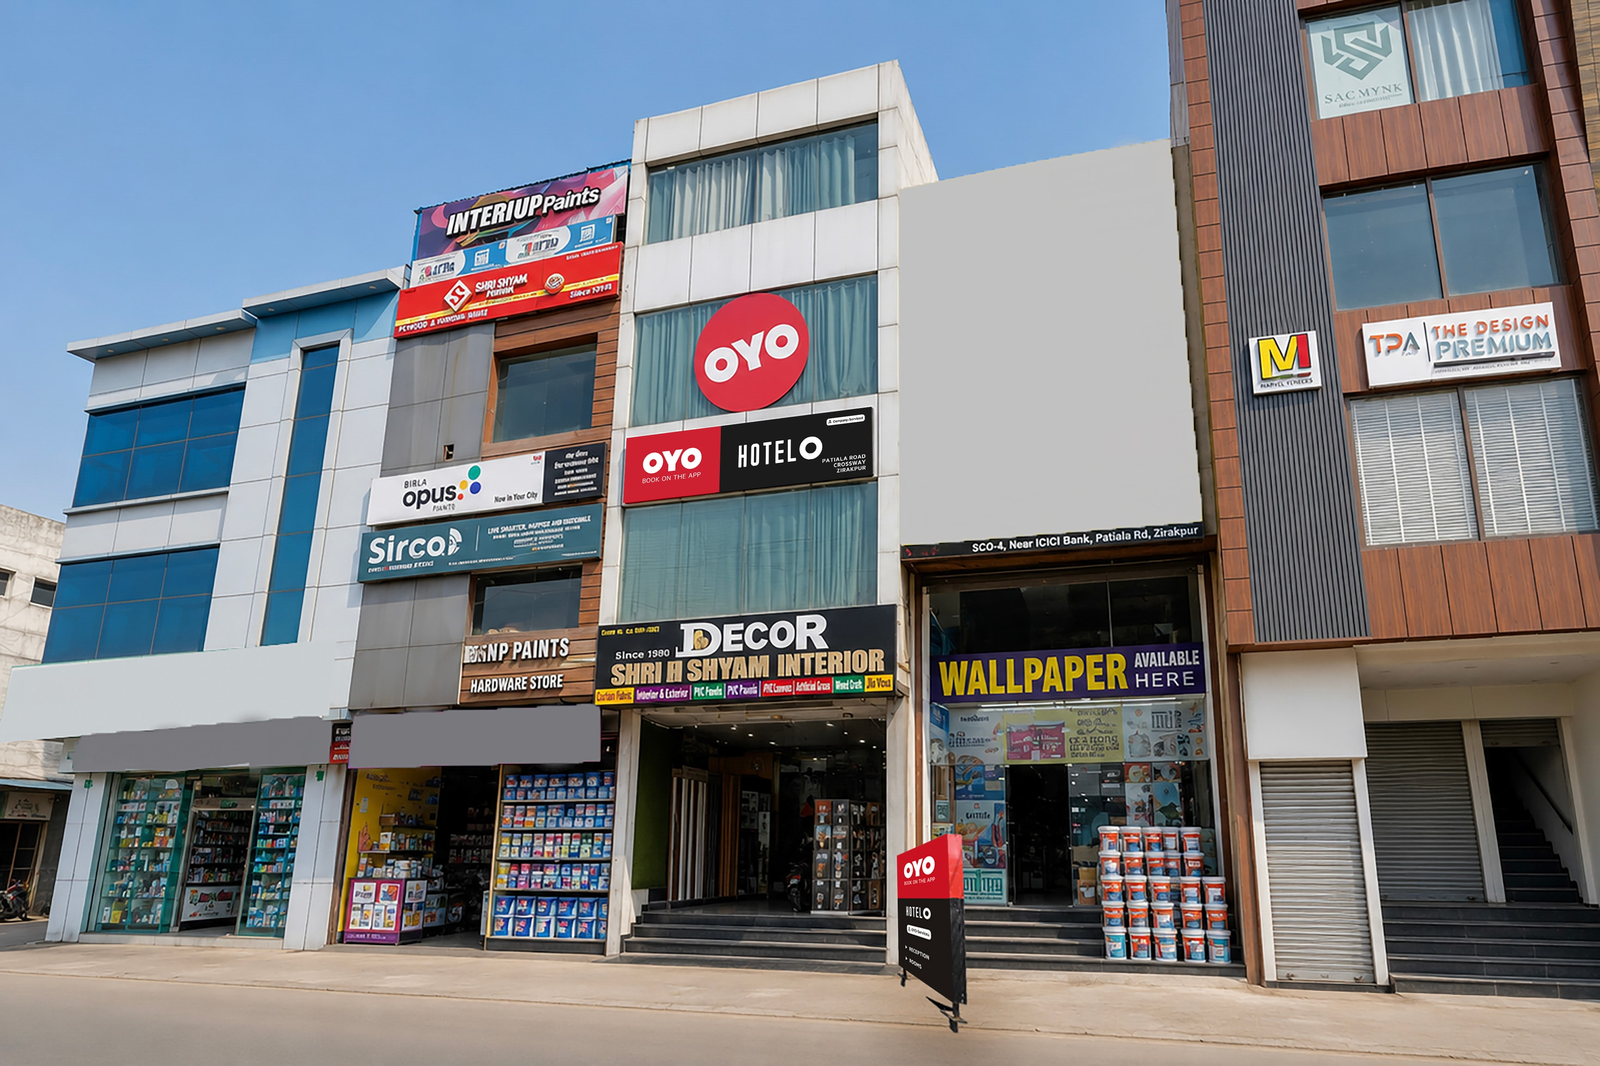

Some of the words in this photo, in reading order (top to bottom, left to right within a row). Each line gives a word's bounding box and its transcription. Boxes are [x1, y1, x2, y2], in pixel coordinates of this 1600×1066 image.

[1324, 90, 1355, 104] SAC
[1358, 83, 1403, 99] MYNK
[446, 194, 543, 236] INTERIUP
[542, 186, 600, 214] Paints
[1433, 323, 1467, 340] THE
[1476, 314, 1549, 335] DESIGN
[704, 323, 800, 383] OYO
[1369, 331, 1421, 356] TPA
[1436, 331, 1552, 360] PREMIUM
[642, 447, 702, 474] OYO
[737, 439, 797, 468] HOTEL
[799, 436, 823, 460] O
[833, 459, 866, 468] CROSSWAY
[688, 471, 701, 479] APP
[836, 465, 867, 474] ZIRAKPUR
[404, 479, 427, 489] BIRLA
[972, 540, 1007, 554] SCO-4,
[1009, 538, 1033, 551] Near
[1035, 536, 1061, 548] ICICI
[1063, 533, 1094, 547] Bank,
[1095, 530, 1132, 543] Patiala
[1133, 528, 1152, 541] Rd,
[1153, 526, 1199, 539] Zirakpur
[676, 614, 829, 658] DECOR
[512, 638, 570, 660] PAINTS
[611, 661, 662, 686] SHRI
[687, 655, 770, 682] SHYAM
[777, 649, 886, 678] INTERIOR
[938, 653, 1129, 697] WALLPAPER
[1134, 650, 1200, 668] AVAILABLE
[470, 677, 528, 693] HARDWARE
[529, 674, 564, 690] STORE
[1135, 671, 1196, 689] HERE
[904, 856, 935, 878] OYO
[905, 906, 923, 919] HOTEL
[909, 958, 923, 970] ROOMS
